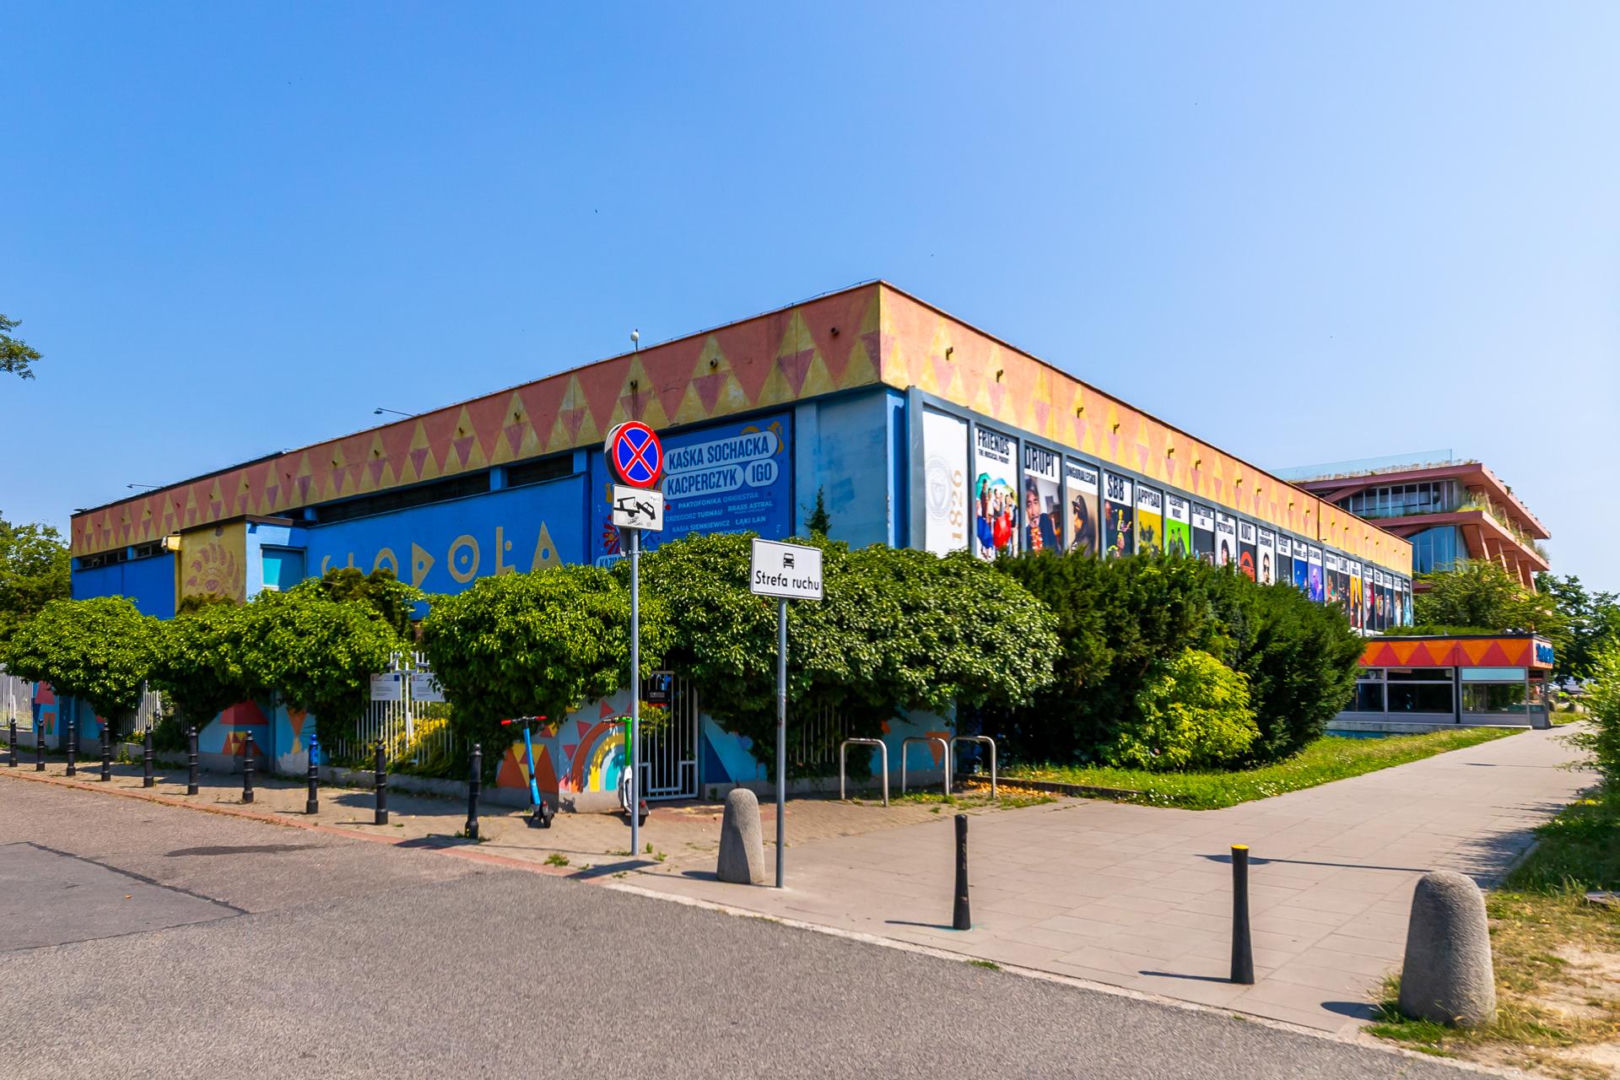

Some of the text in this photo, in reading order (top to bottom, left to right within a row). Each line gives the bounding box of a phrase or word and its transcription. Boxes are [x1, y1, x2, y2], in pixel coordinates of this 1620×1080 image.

[668, 436, 769, 471] KAŚKA SOCHACKA
[978, 428, 1009, 456] FRIENDS
[752, 462, 772, 483] IGO
[1024, 445, 1055, 477] DRUPI
[667, 468, 737, 496] KACPERCZYK
[1107, 474, 1124, 501] SBB
[755, 570, 820, 591] Strefa ruchu
